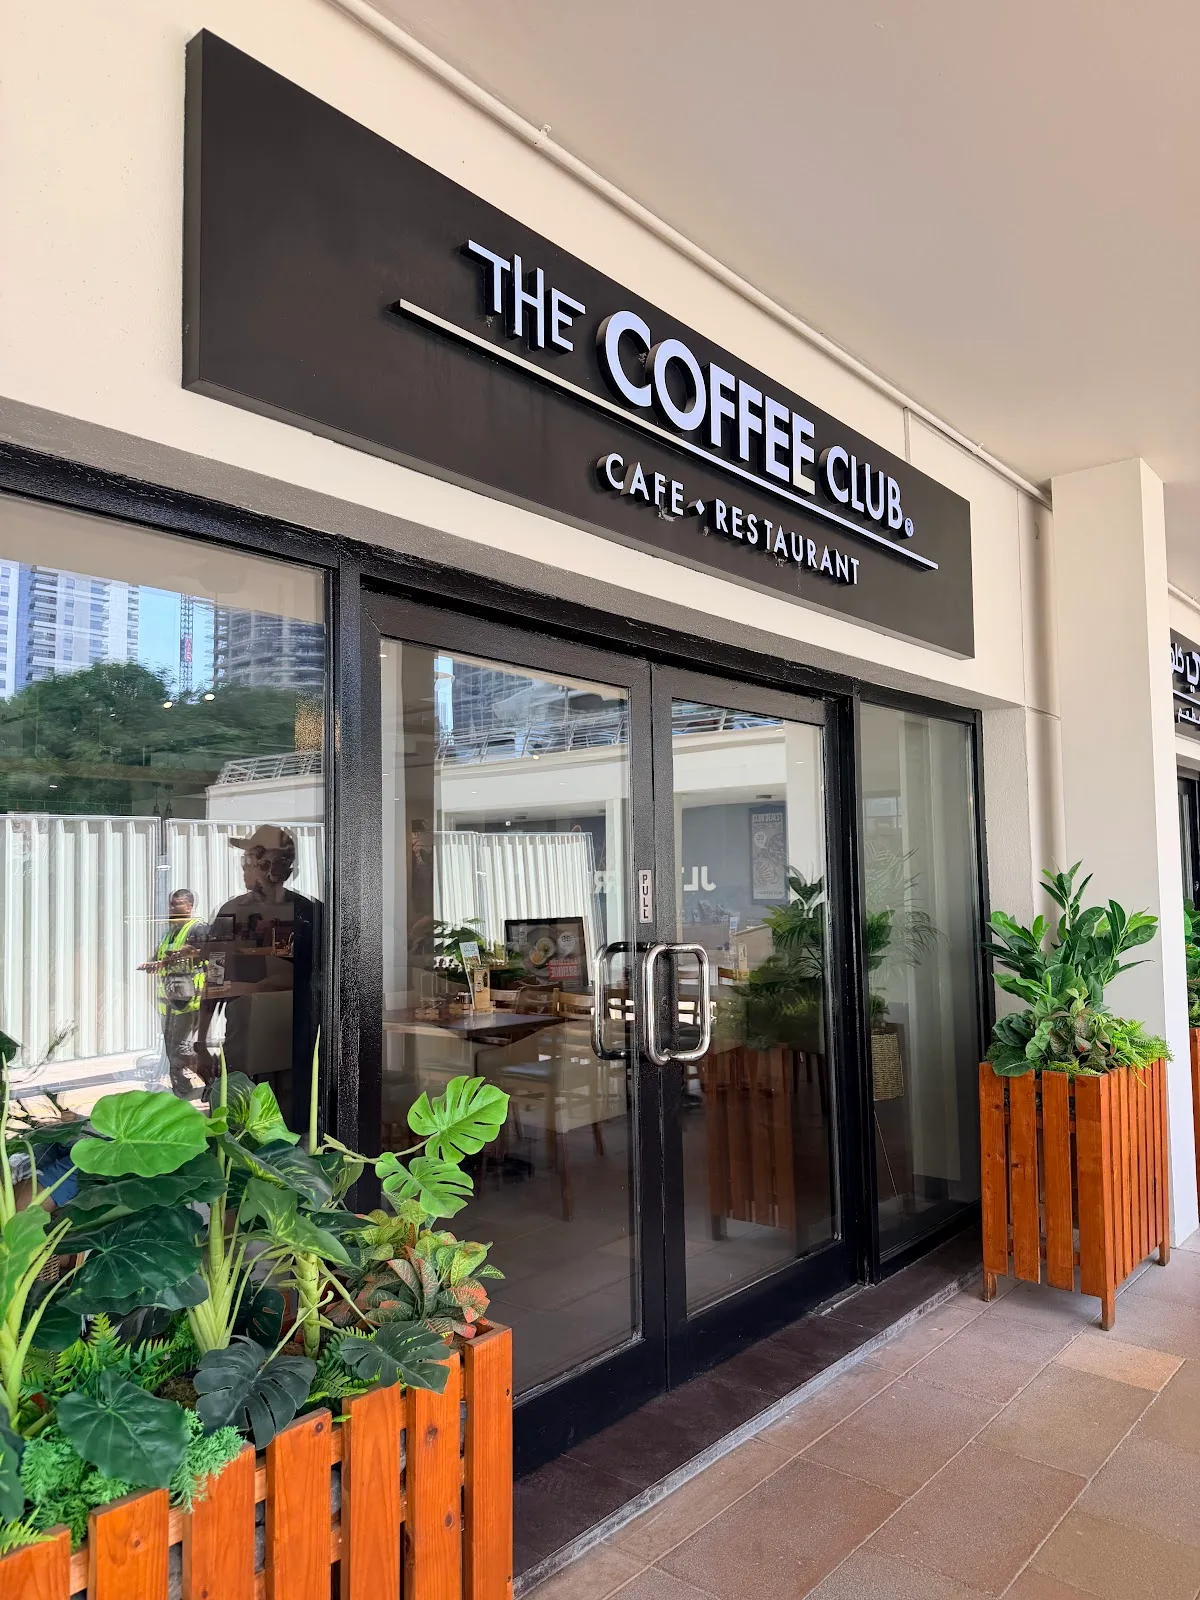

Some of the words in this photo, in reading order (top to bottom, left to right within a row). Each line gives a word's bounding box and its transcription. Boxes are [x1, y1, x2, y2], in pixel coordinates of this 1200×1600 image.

[467, 239, 587, 353] THE
[602, 309, 816, 497] COFFEE
[602, 452, 685, 517] CAFE
[714, 498, 860, 585] RESTAURANT
